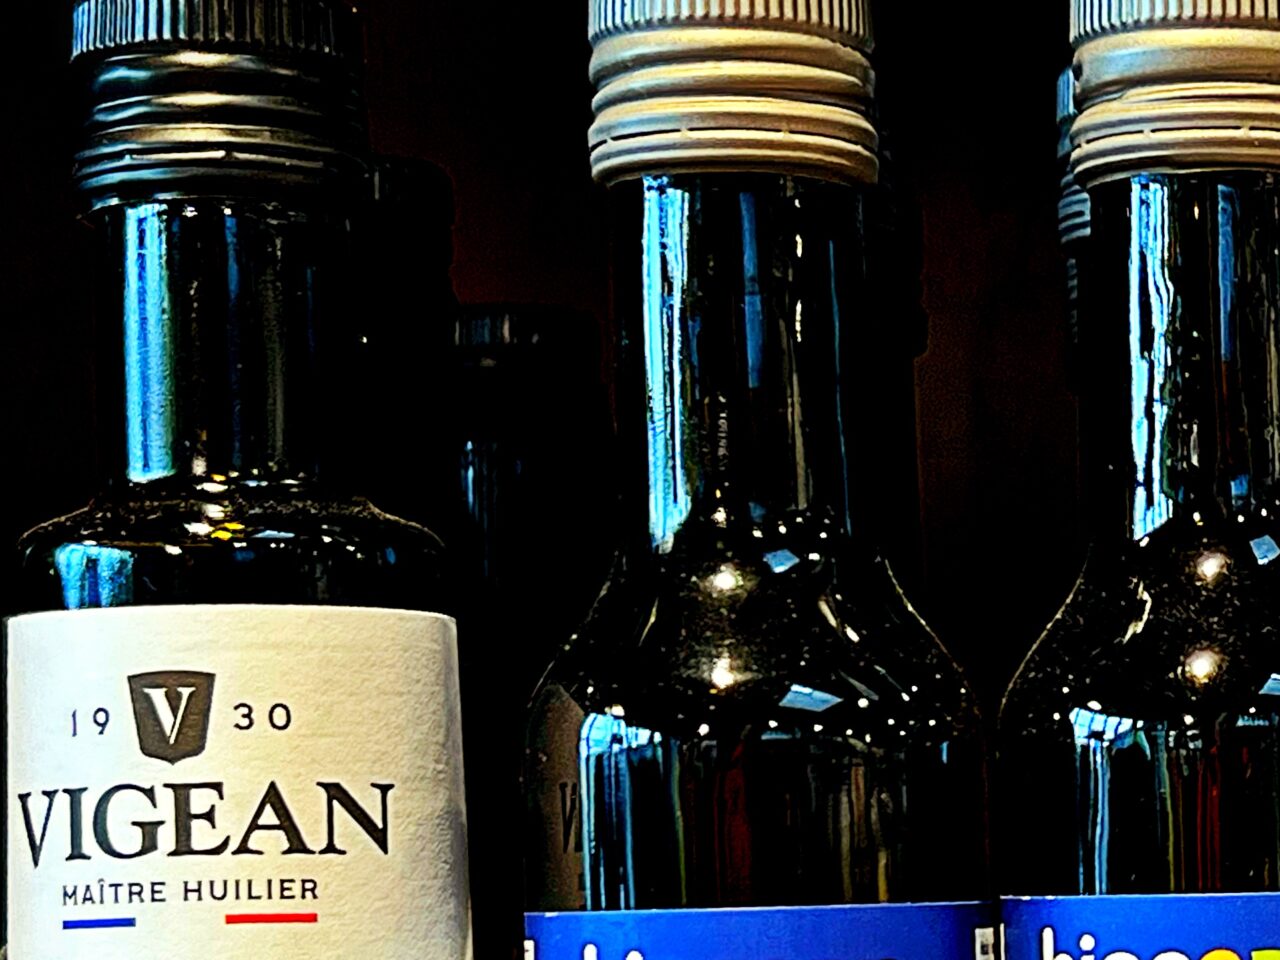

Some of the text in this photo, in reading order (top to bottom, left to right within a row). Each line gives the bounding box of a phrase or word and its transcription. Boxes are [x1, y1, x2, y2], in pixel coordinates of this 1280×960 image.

[143, 686, 196, 745] V
[18, 781, 395, 869] VIGEAN
[62, 878, 319, 906] MAÎTRE HUILIER
